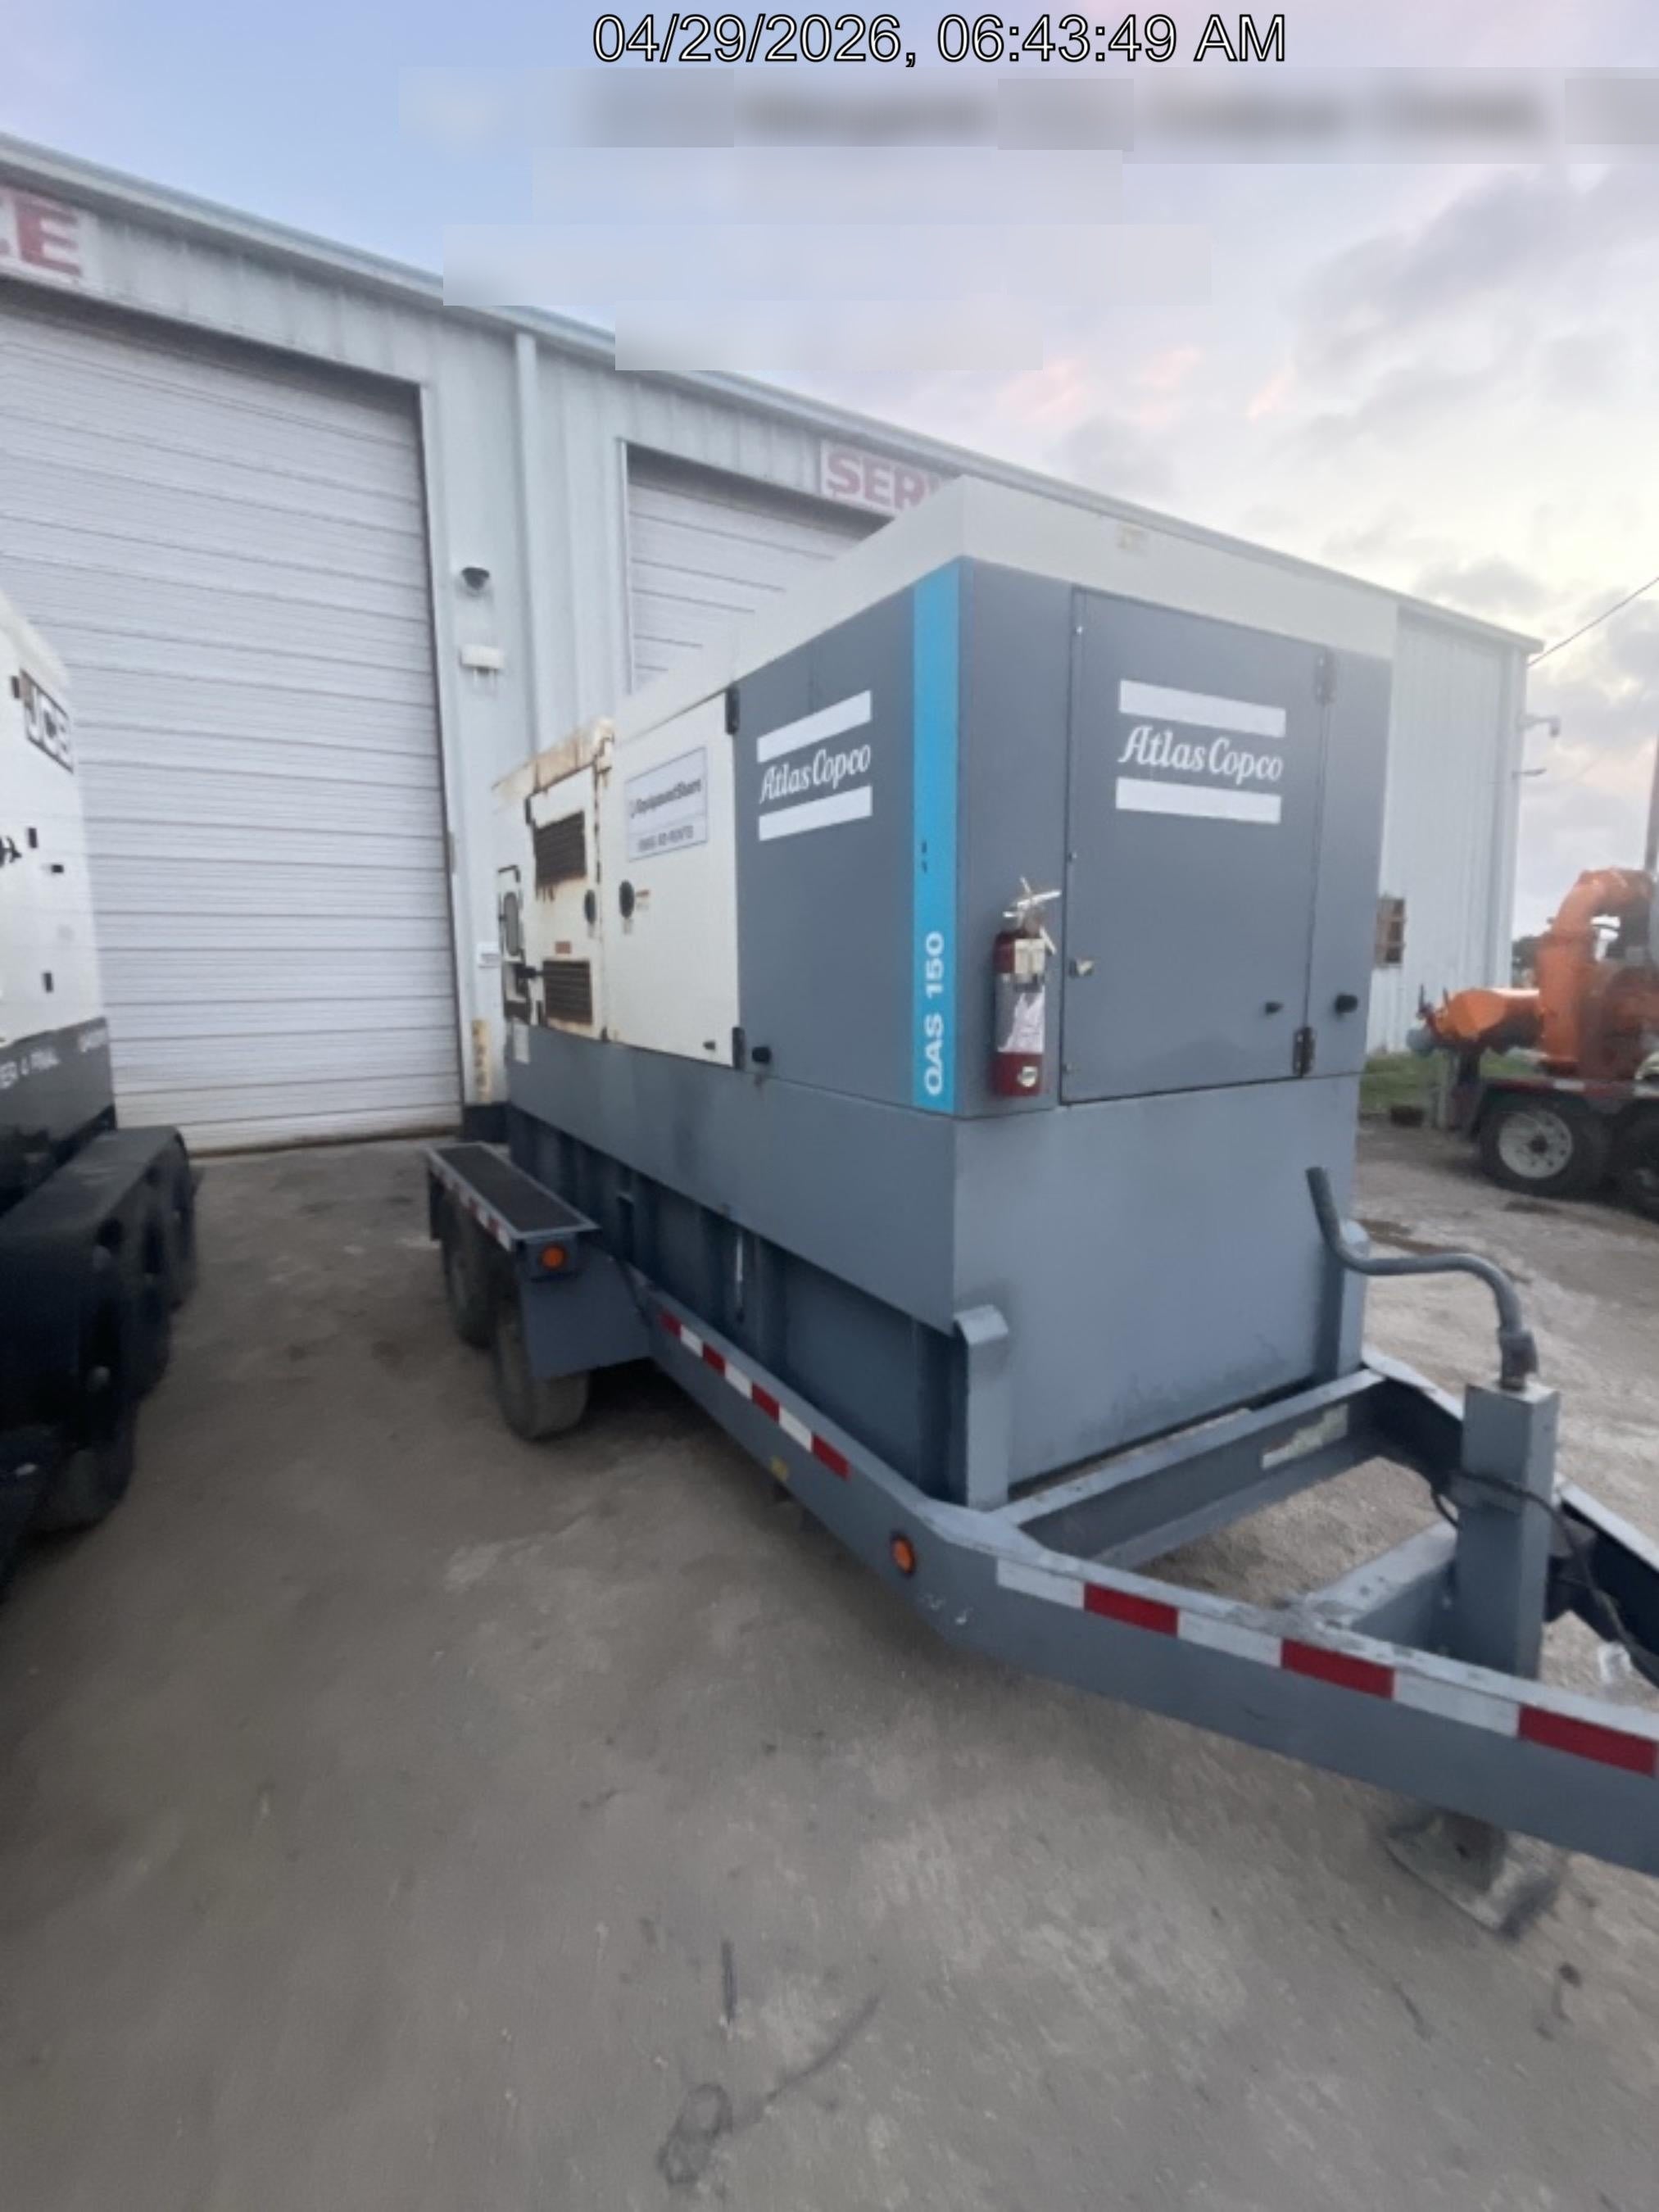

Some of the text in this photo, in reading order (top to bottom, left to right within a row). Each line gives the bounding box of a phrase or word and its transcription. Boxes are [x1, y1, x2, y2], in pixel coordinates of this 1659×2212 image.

[0, 190, 83, 277] E
[759, 744, 872, 805] Atlas Copco
[1117, 725, 1283, 786] Atlas Copco
[924, 931, 945, 1095] QAS 150
